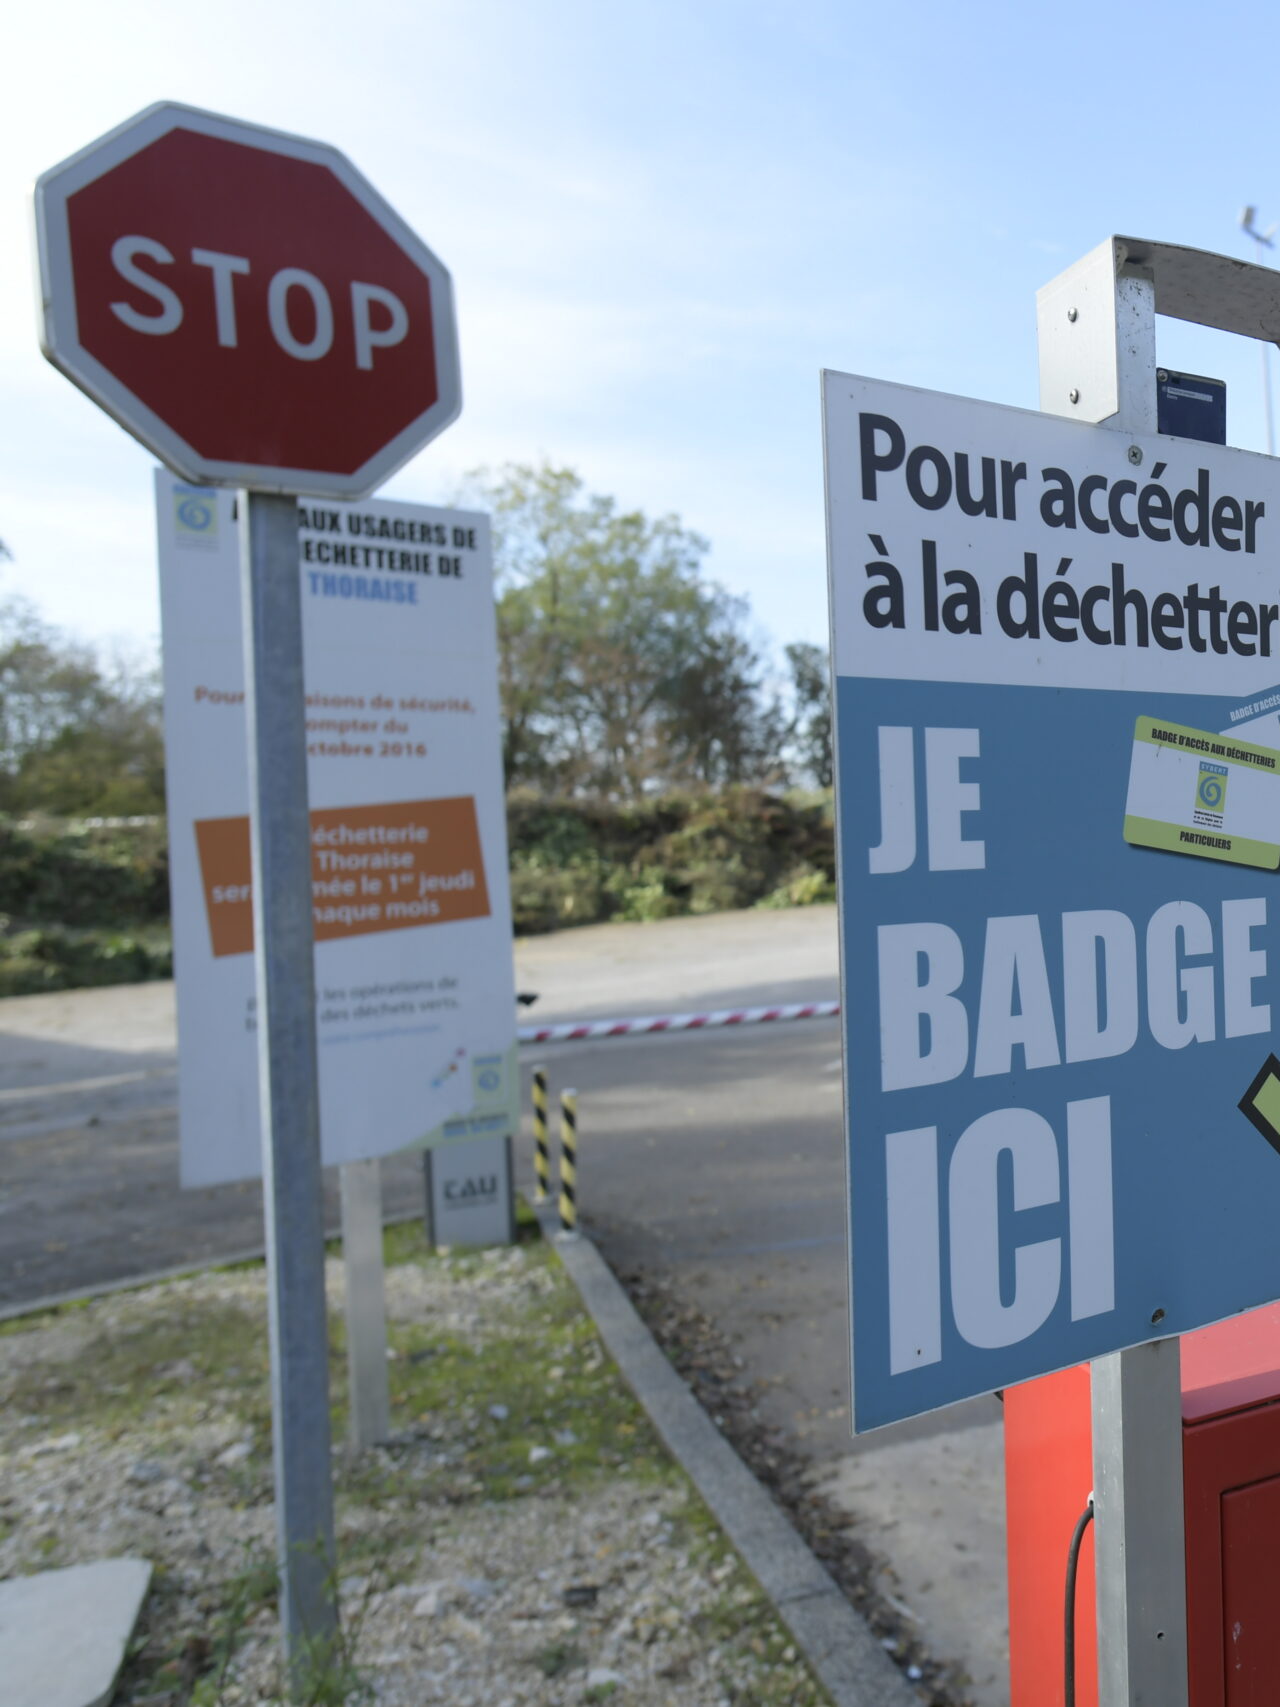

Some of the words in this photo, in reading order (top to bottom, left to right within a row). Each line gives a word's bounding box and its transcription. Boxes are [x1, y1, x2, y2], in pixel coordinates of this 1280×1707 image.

[109, 234, 410, 372] STOP
[858, 412, 1027, 520] Pour
[1040, 462, 1265, 553] accéder
[347, 513, 447, 547] USAGERS
[452, 525, 477, 550] DE
[303, 539, 433, 575] ECHETTERIE
[438, 554, 464, 579] DE
[307, 571, 419, 606] THORAISE
[863, 534, 906, 630] à
[921, 539, 983, 636] la
[304, 690, 365, 710] aisons
[1229, 704, 1254, 722] BADGE
[304, 717, 378, 736] ompter
[307, 740, 374, 758] ctobre
[379, 741, 428, 758] 2016
[1151, 728, 1178, 744] BADGE
[1210, 743, 1226, 756] AUX
[1226, 747, 1276, 769] DÉCHETTERIES
[868, 725, 986, 874] JE
[311, 823, 429, 846] échetterie
[1179, 831, 1232, 850] PARTICULIERS
[315, 849, 415, 872] Thoraise
[361, 875, 383, 895] le
[419, 870, 475, 896] jeudi
[386, 897, 440, 920] mois
[877, 897, 1272, 1092] BADGE
[884, 1095, 1116, 1376] ICI
